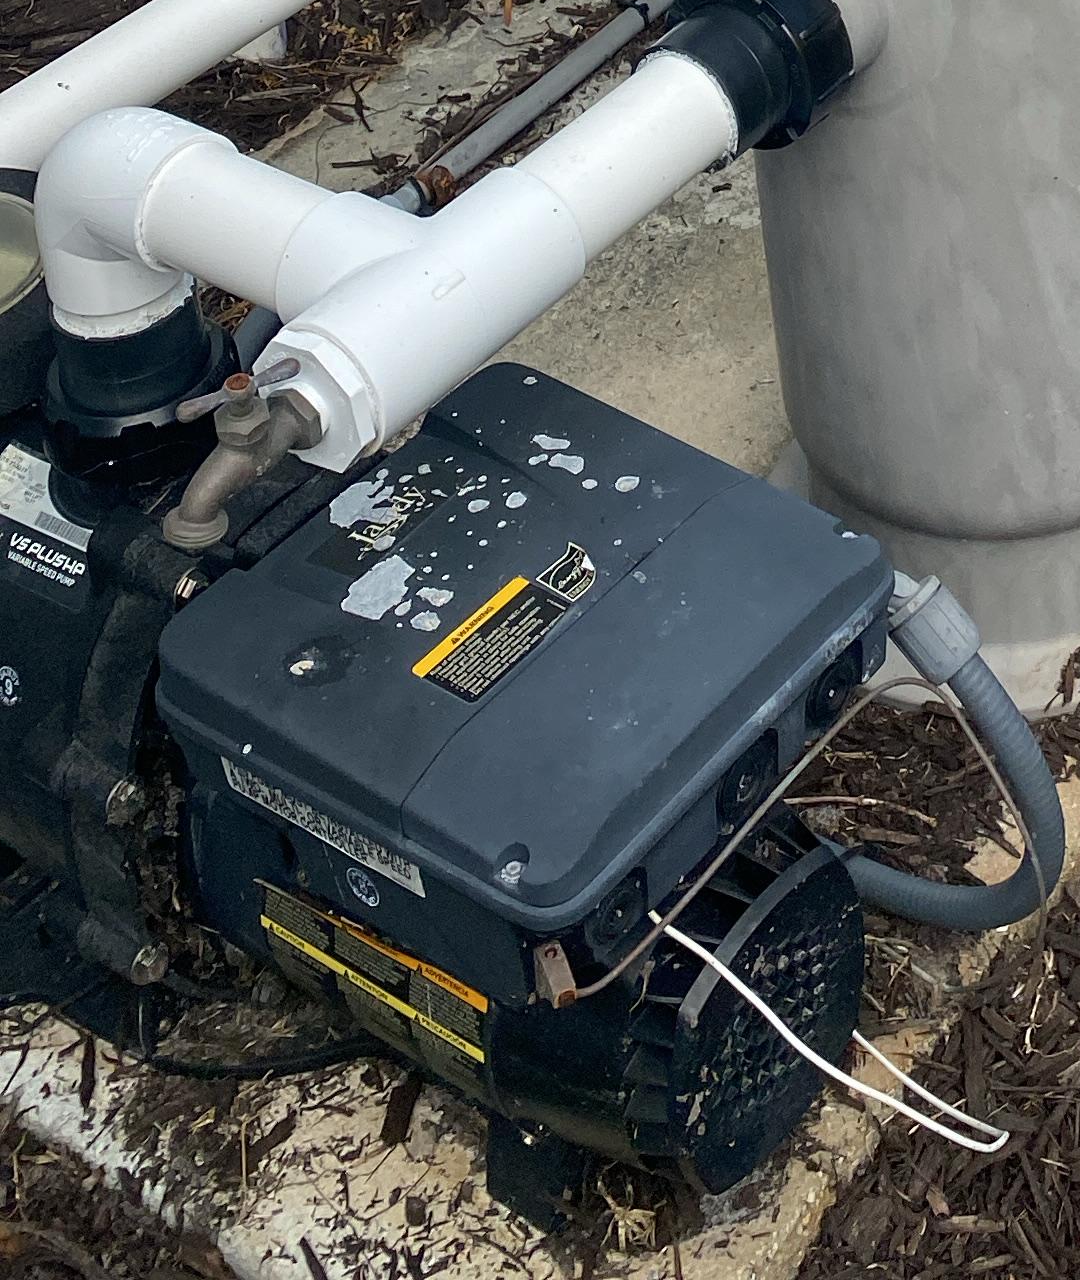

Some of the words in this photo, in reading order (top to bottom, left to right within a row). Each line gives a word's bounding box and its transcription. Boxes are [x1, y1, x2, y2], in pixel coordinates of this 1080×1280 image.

[9, 533, 31, 551] VS
[8, 550, 38, 571] VARIABLE
[36, 563, 57, 580] SPEED
[55, 571, 76, 587] PUMP
